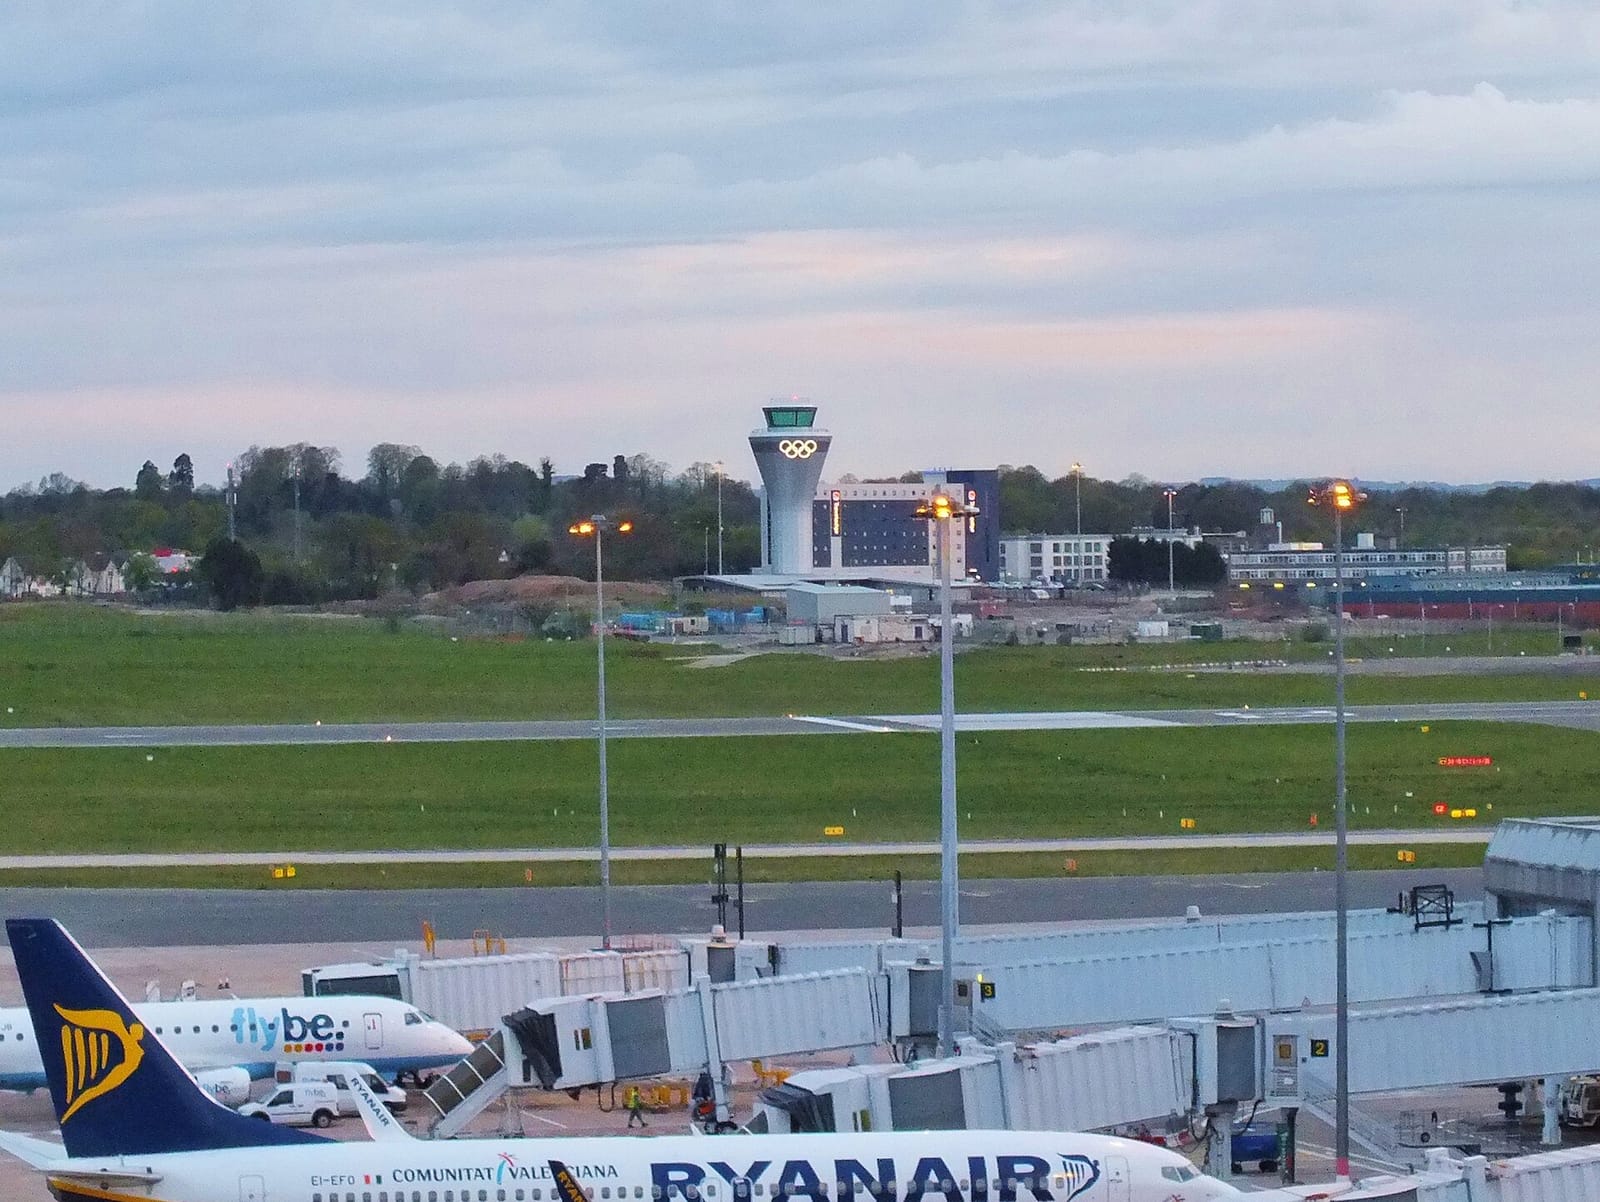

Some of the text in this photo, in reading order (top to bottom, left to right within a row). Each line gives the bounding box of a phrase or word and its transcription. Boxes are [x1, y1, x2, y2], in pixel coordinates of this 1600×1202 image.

[984, 984, 993, 997] 3
[1315, 1042, 1325, 1055] 2
[351, 1077, 390, 1127] RYANAIR
[392, 1164, 619, 1183] COMUNITAT VALEIANA
[650, 1155, 1056, 1202] RYANAIR
